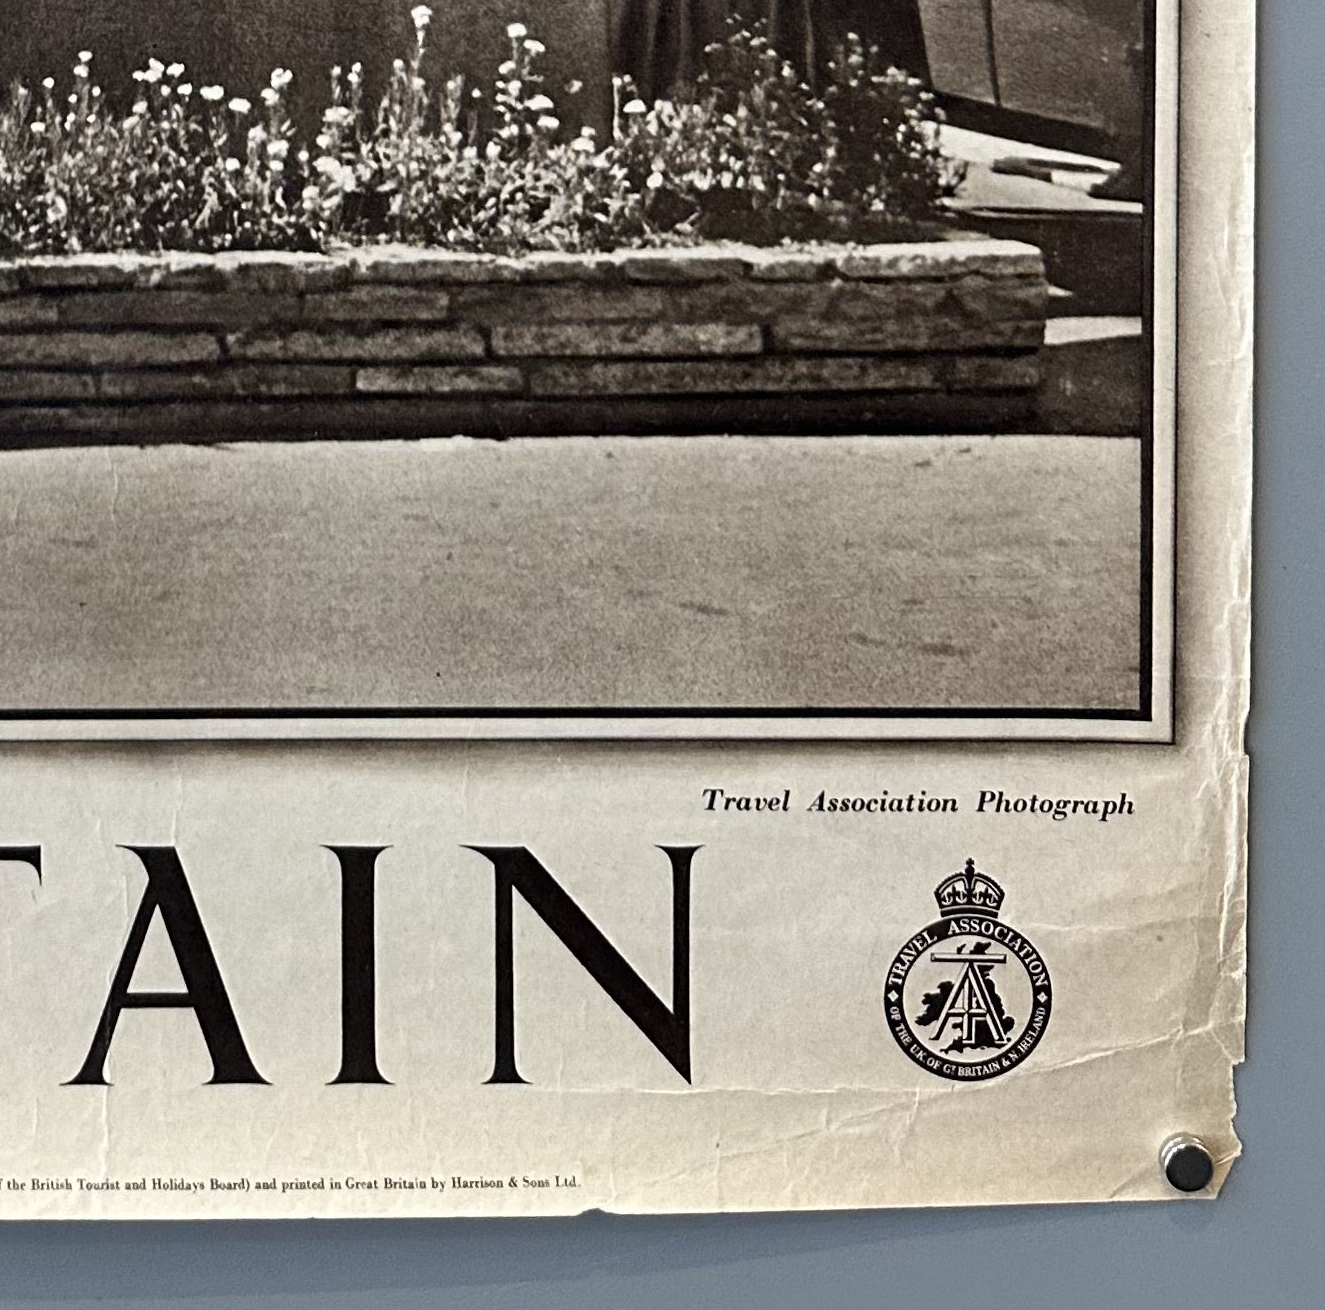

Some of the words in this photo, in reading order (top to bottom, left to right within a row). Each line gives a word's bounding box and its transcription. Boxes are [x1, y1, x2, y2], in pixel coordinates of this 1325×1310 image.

[701, 788, 791, 813] Travel
[806, 789, 959, 814] Association
[975, 790, 1135, 823] Photograph
[888, 931, 937, 986] TRAVEL
[948, 918, 1049, 987] ASSOCIATION
[890, 1006, 901, 1021] OF
[896, 1023, 913, 1046] THE
[927, 1056, 942, 1070] OF
[957, 1061, 1001, 1077] BRITAIN
[1018, 1007, 1046, 1053] IRELAND
[6, 1177, 27, 1191] the
[30, 1177, 73, 1191] British
[76, 1177, 121, 1191] Tourist
[124, 1177, 147, 1191] and
[151, 1177, 206, 1195] Holidays
[209, 1177, 251, 1193] Board)
[254, 1177, 278, 1191] and
[281, 1177, 326, 1194] printed
[329, 1177, 342, 1190] in
[345, 1177, 379, 1190] Great
[383, 1176, 427, 1190] Britain
[430, 1176, 447, 1193] by
[450, 1176, 504, 1189] Harrison
[507, 1176, 519, 1189] &
[522, 1176, 551, 1189] Sons
[554, 1175, 582, 1189] Ltd.
